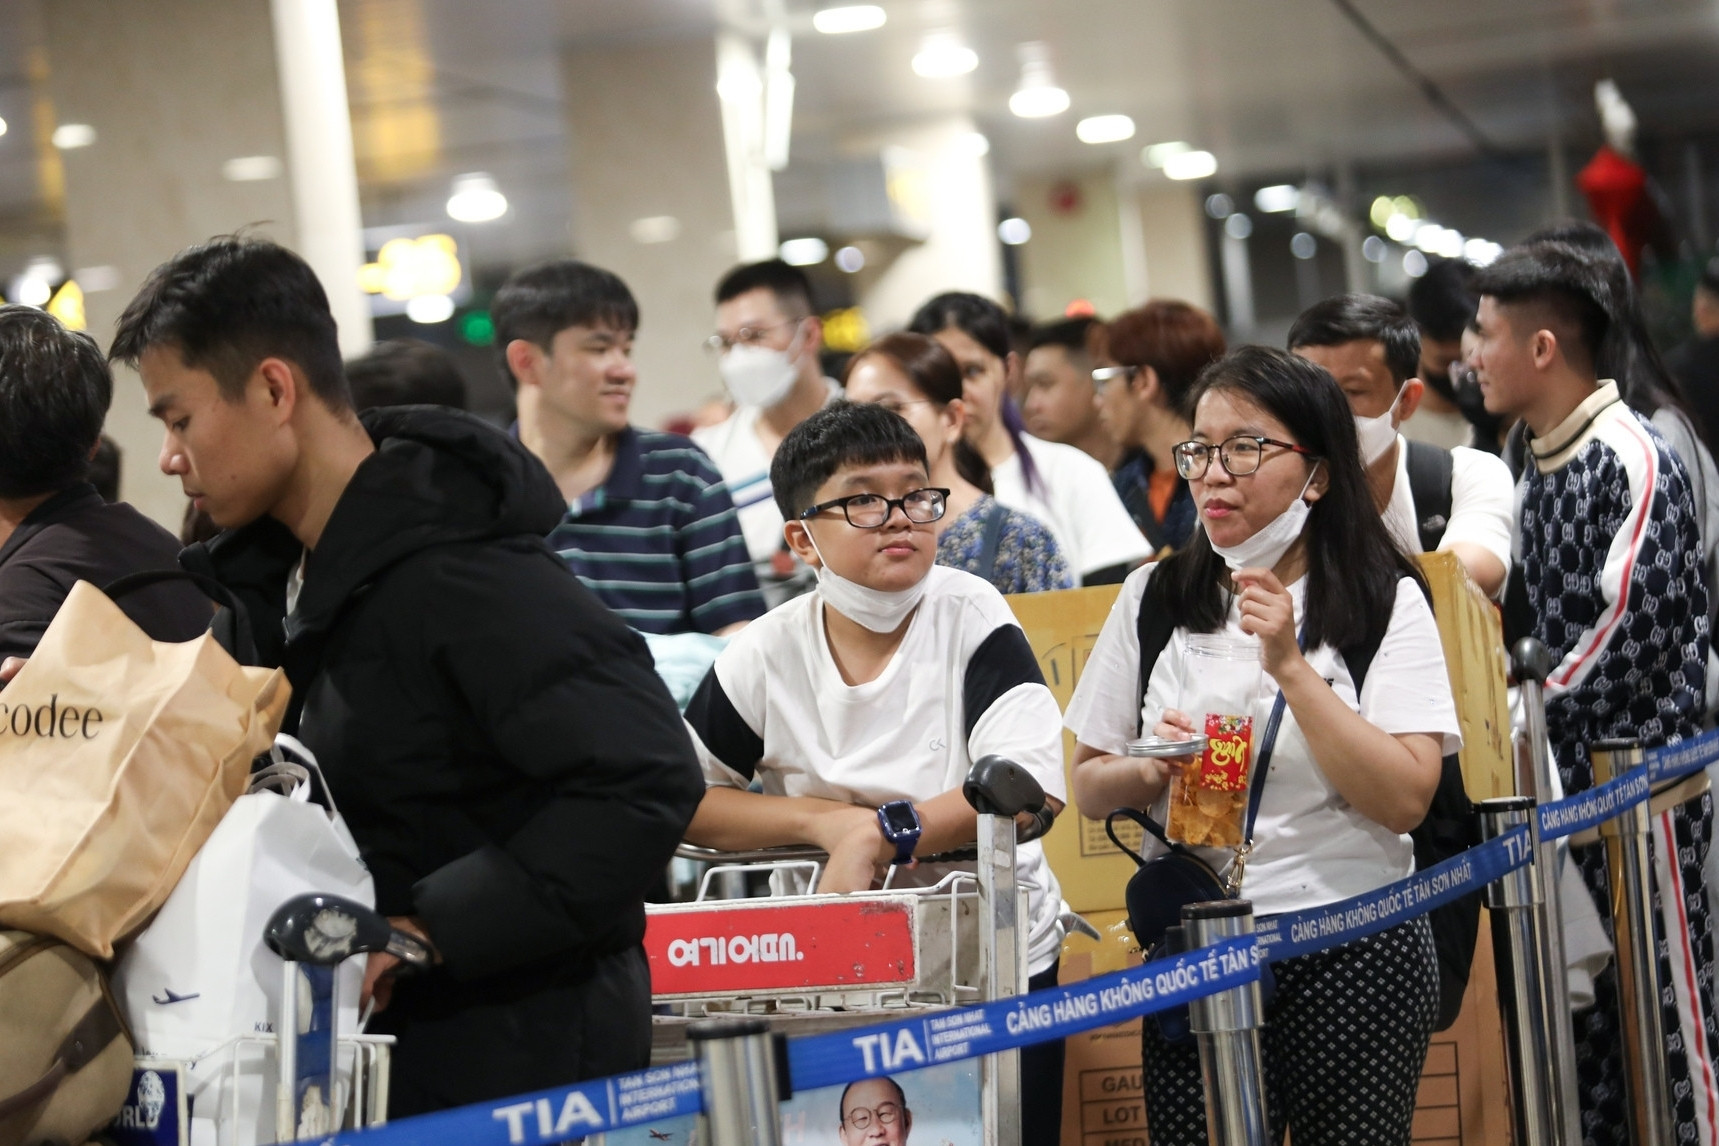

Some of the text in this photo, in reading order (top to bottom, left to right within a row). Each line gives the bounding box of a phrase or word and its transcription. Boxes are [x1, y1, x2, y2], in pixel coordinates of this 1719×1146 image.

[1502, 829, 1532, 867] TIA
[1291, 856, 1472, 944] CẢNG HÀNG KHÔNG QUỐC TẾ TÂN SƠN NHẤT
[1006, 1001, 1050, 1036] CẢNG
[1053, 991, 1098, 1024] HÀNG
[1099, 976, 1154, 1012] KHÔNG
[1155, 957, 1199, 995] QUỐC
[1199, 948, 1219, 982] TẾ
[1219, 945, 1249, 975] TÂN
[254, 1021, 273, 1033] KIX
[931, 1022, 993, 1046] INTERNATIONAL
[852, 1027, 926, 1074] TIA
[934, 1042, 970, 1060] AIRPORT
[672, 1061, 698, 1077] NHA
[618, 1077, 700, 1107] INTERNATION
[115, 1104, 160, 1129] RLD
[492, 1090, 604, 1145] TIA
[621, 1096, 678, 1122] AIRPORT
[1102, 1106, 1142, 1125] LOT
